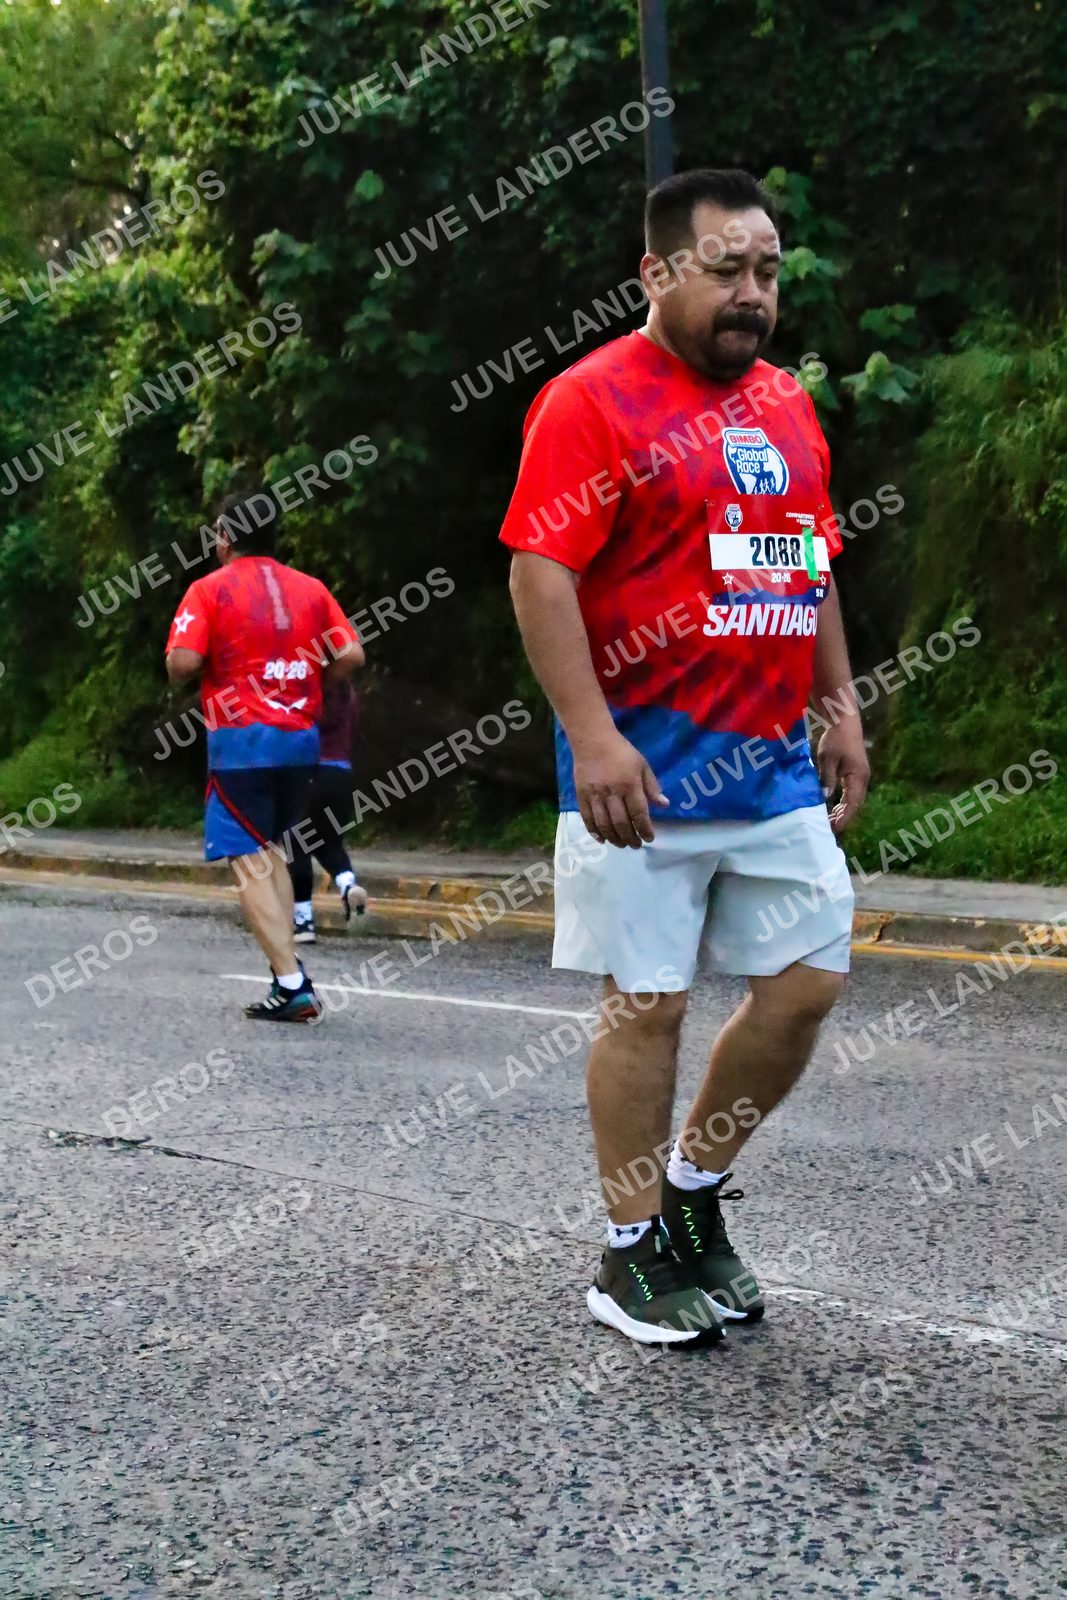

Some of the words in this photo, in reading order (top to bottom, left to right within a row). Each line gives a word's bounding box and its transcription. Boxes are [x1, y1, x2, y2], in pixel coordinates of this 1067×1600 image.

[729, 435, 763, 443] BIMBO
[737, 448, 768, 462] Global
[736, 460, 760, 473] Race
[750, 536, 801, 566] 2088
